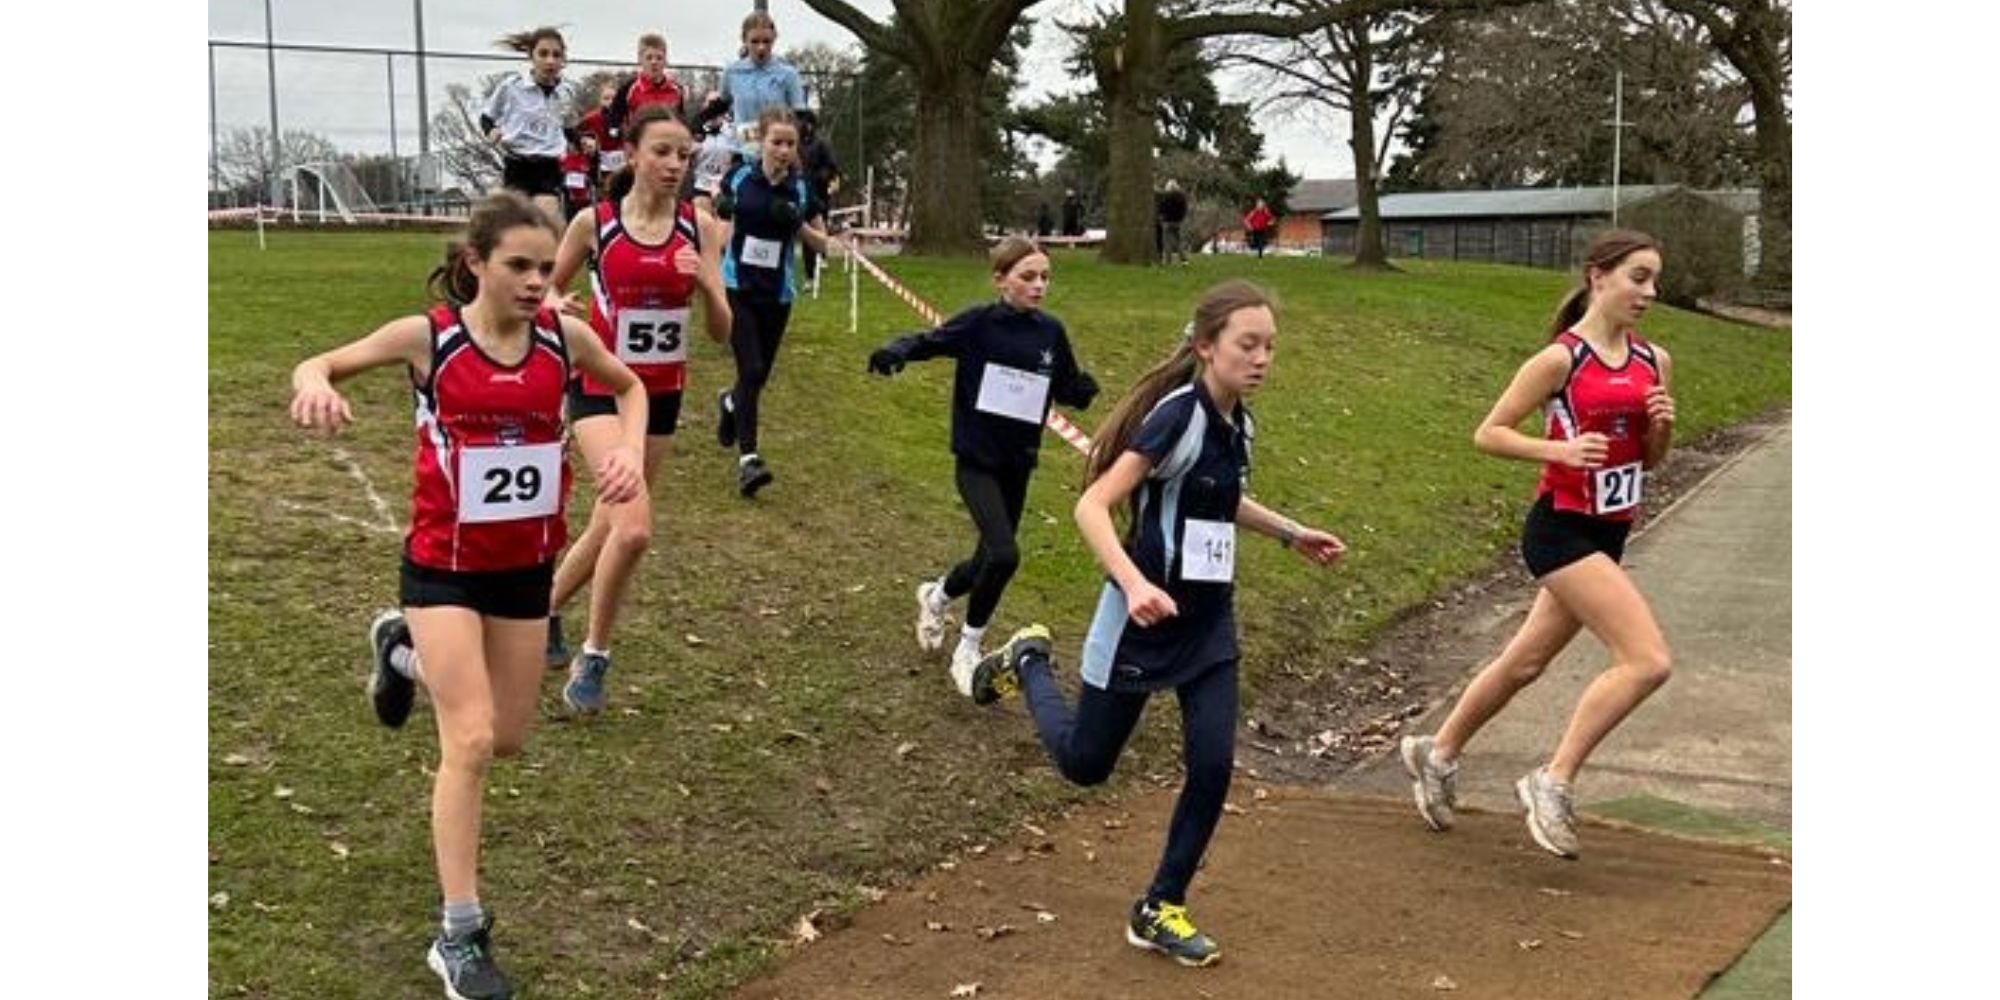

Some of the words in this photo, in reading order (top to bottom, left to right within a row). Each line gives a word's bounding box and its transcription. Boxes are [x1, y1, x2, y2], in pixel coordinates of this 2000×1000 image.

[628, 321, 681, 353] 53
[483, 465, 541, 503] 29
[1604, 468, 1634, 506] 27
